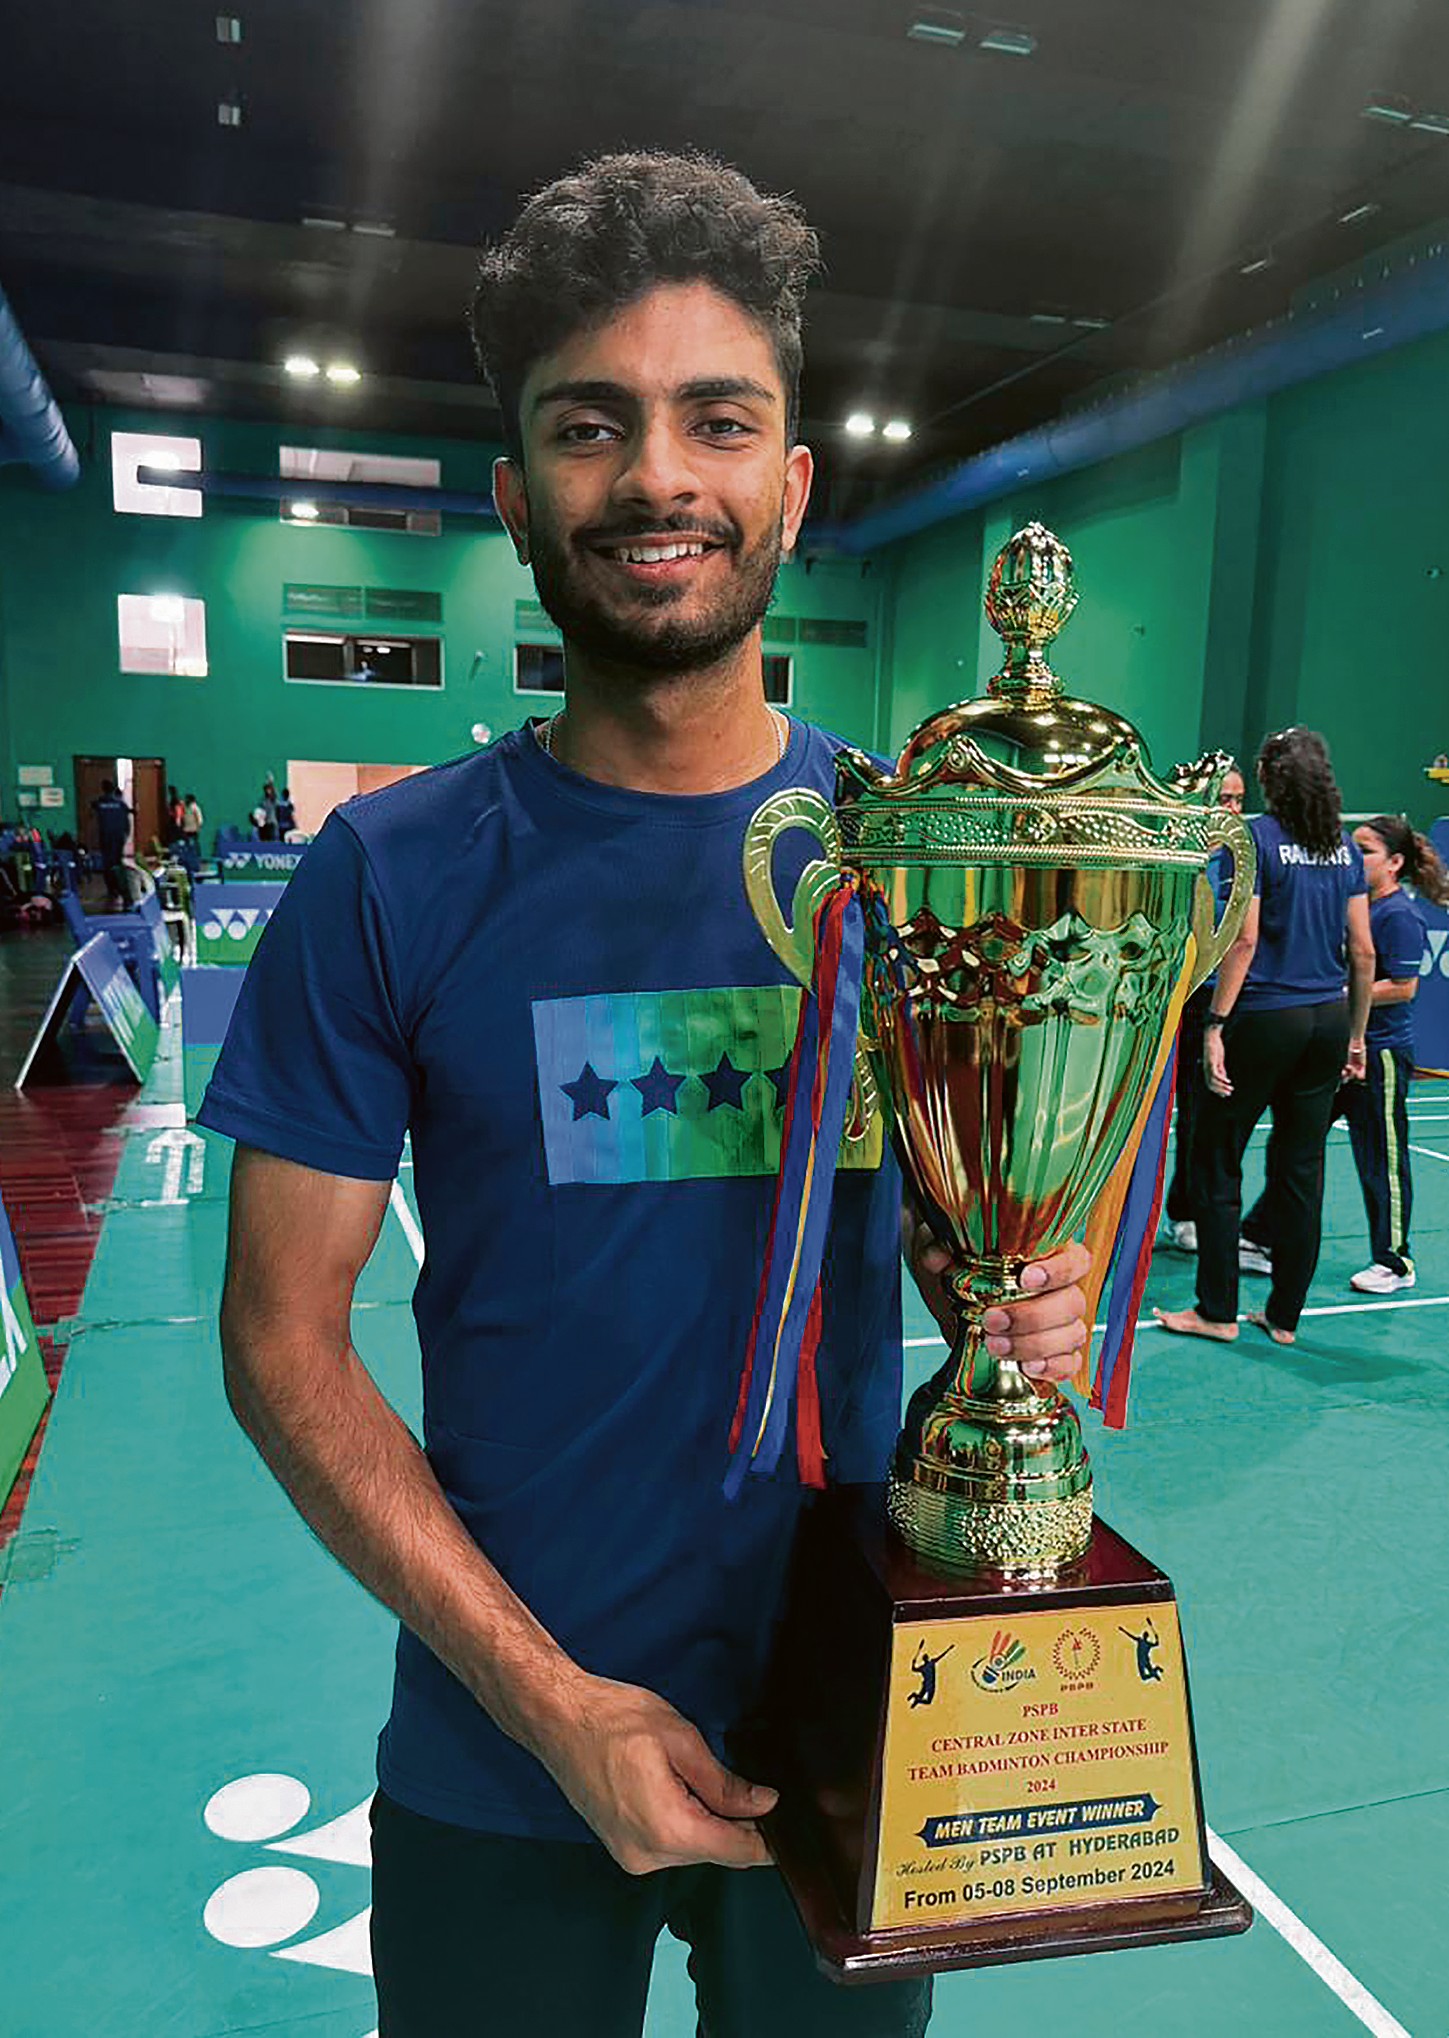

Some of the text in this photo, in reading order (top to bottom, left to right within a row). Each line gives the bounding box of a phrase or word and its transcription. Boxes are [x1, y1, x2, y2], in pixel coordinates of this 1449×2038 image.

[1002, 1668, 1035, 1682] INDIA
[1022, 1703, 1058, 1717] PSPB
[932, 1719, 1146, 1752] CENTRAL ZONE INTER STATE
[907, 1742, 1169, 1781] TEAM BADMINTON CHAMPIONSHIP
[1027, 1778, 1056, 1792] 2024
[935, 1800, 1144, 1839] MEN TEAM EVENT WINNER
[896, 1828, 1179, 1876] Hosted By PSPB AT HYDERABAD
[904, 1859, 1175, 1908] From 05-08 September 2024
